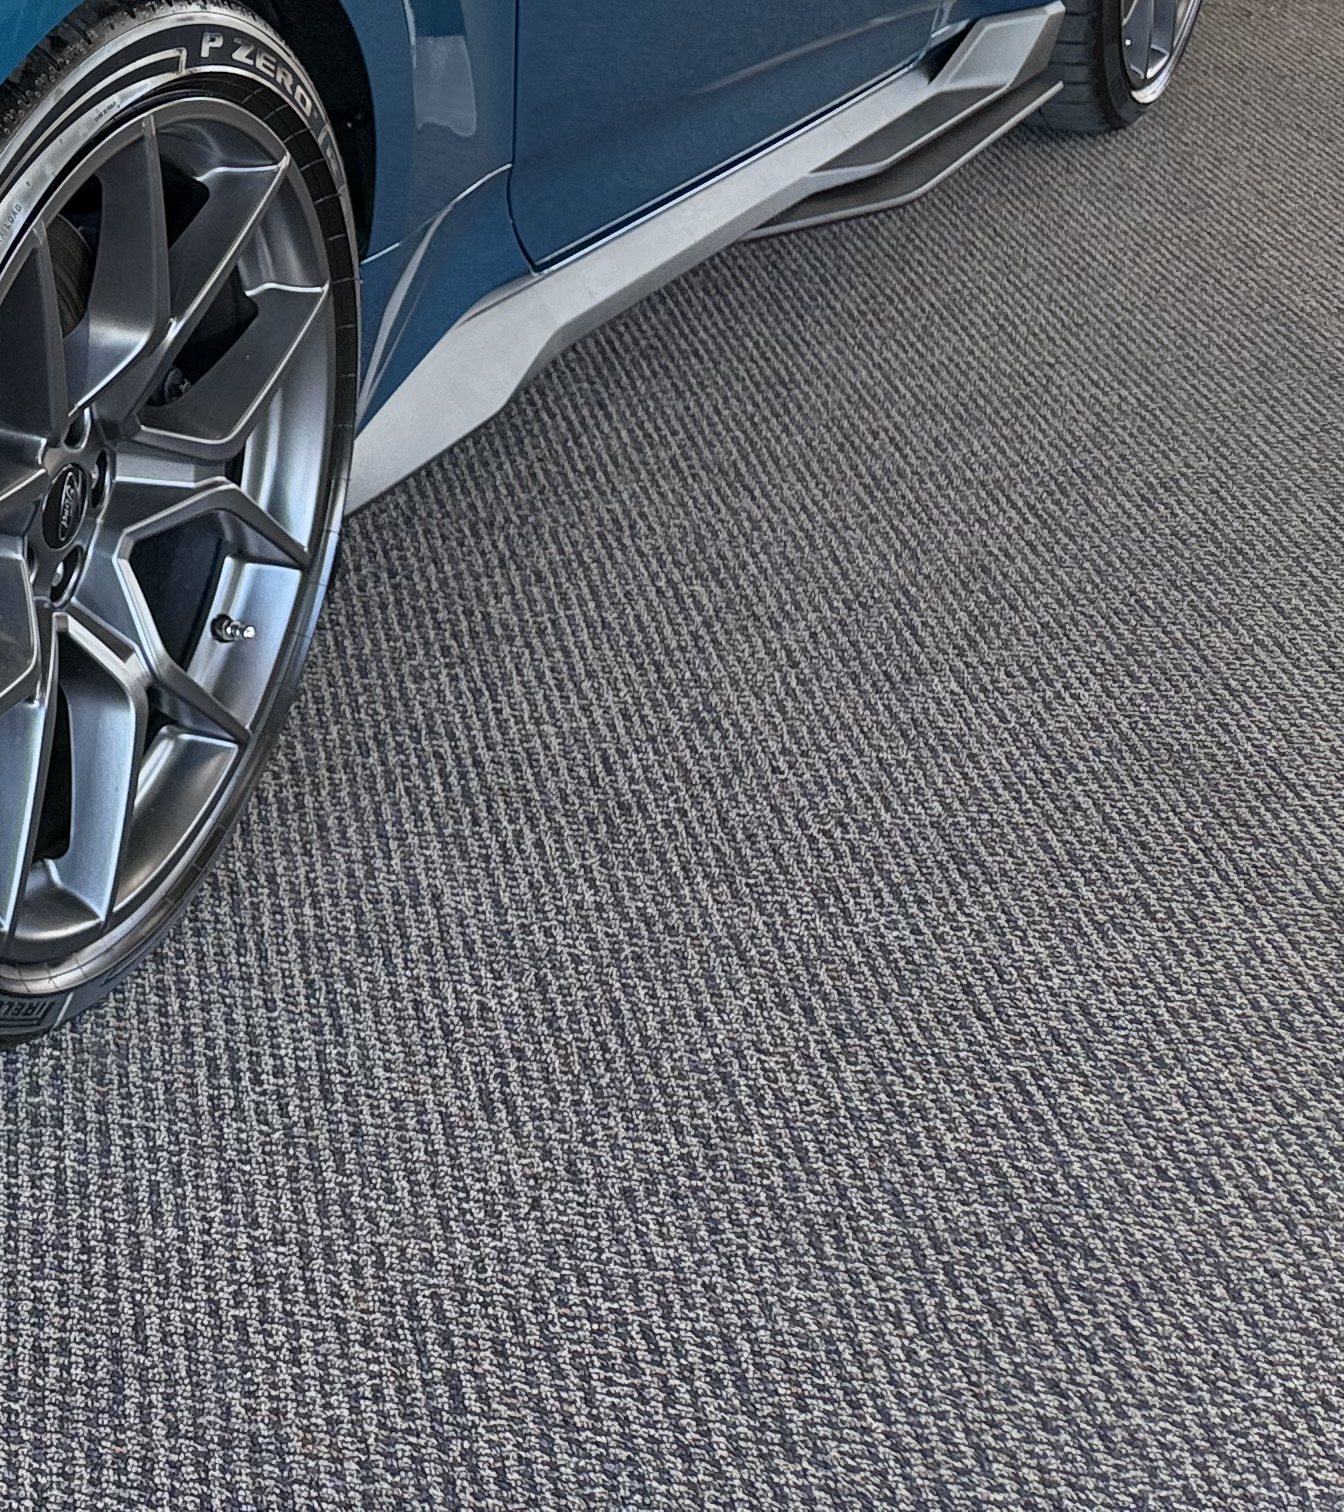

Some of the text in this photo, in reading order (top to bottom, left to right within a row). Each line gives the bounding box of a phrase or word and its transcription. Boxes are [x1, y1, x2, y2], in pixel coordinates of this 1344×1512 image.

[200, 32, 314, 117] P ZERO
[6, 203, 23, 231] LOAD
